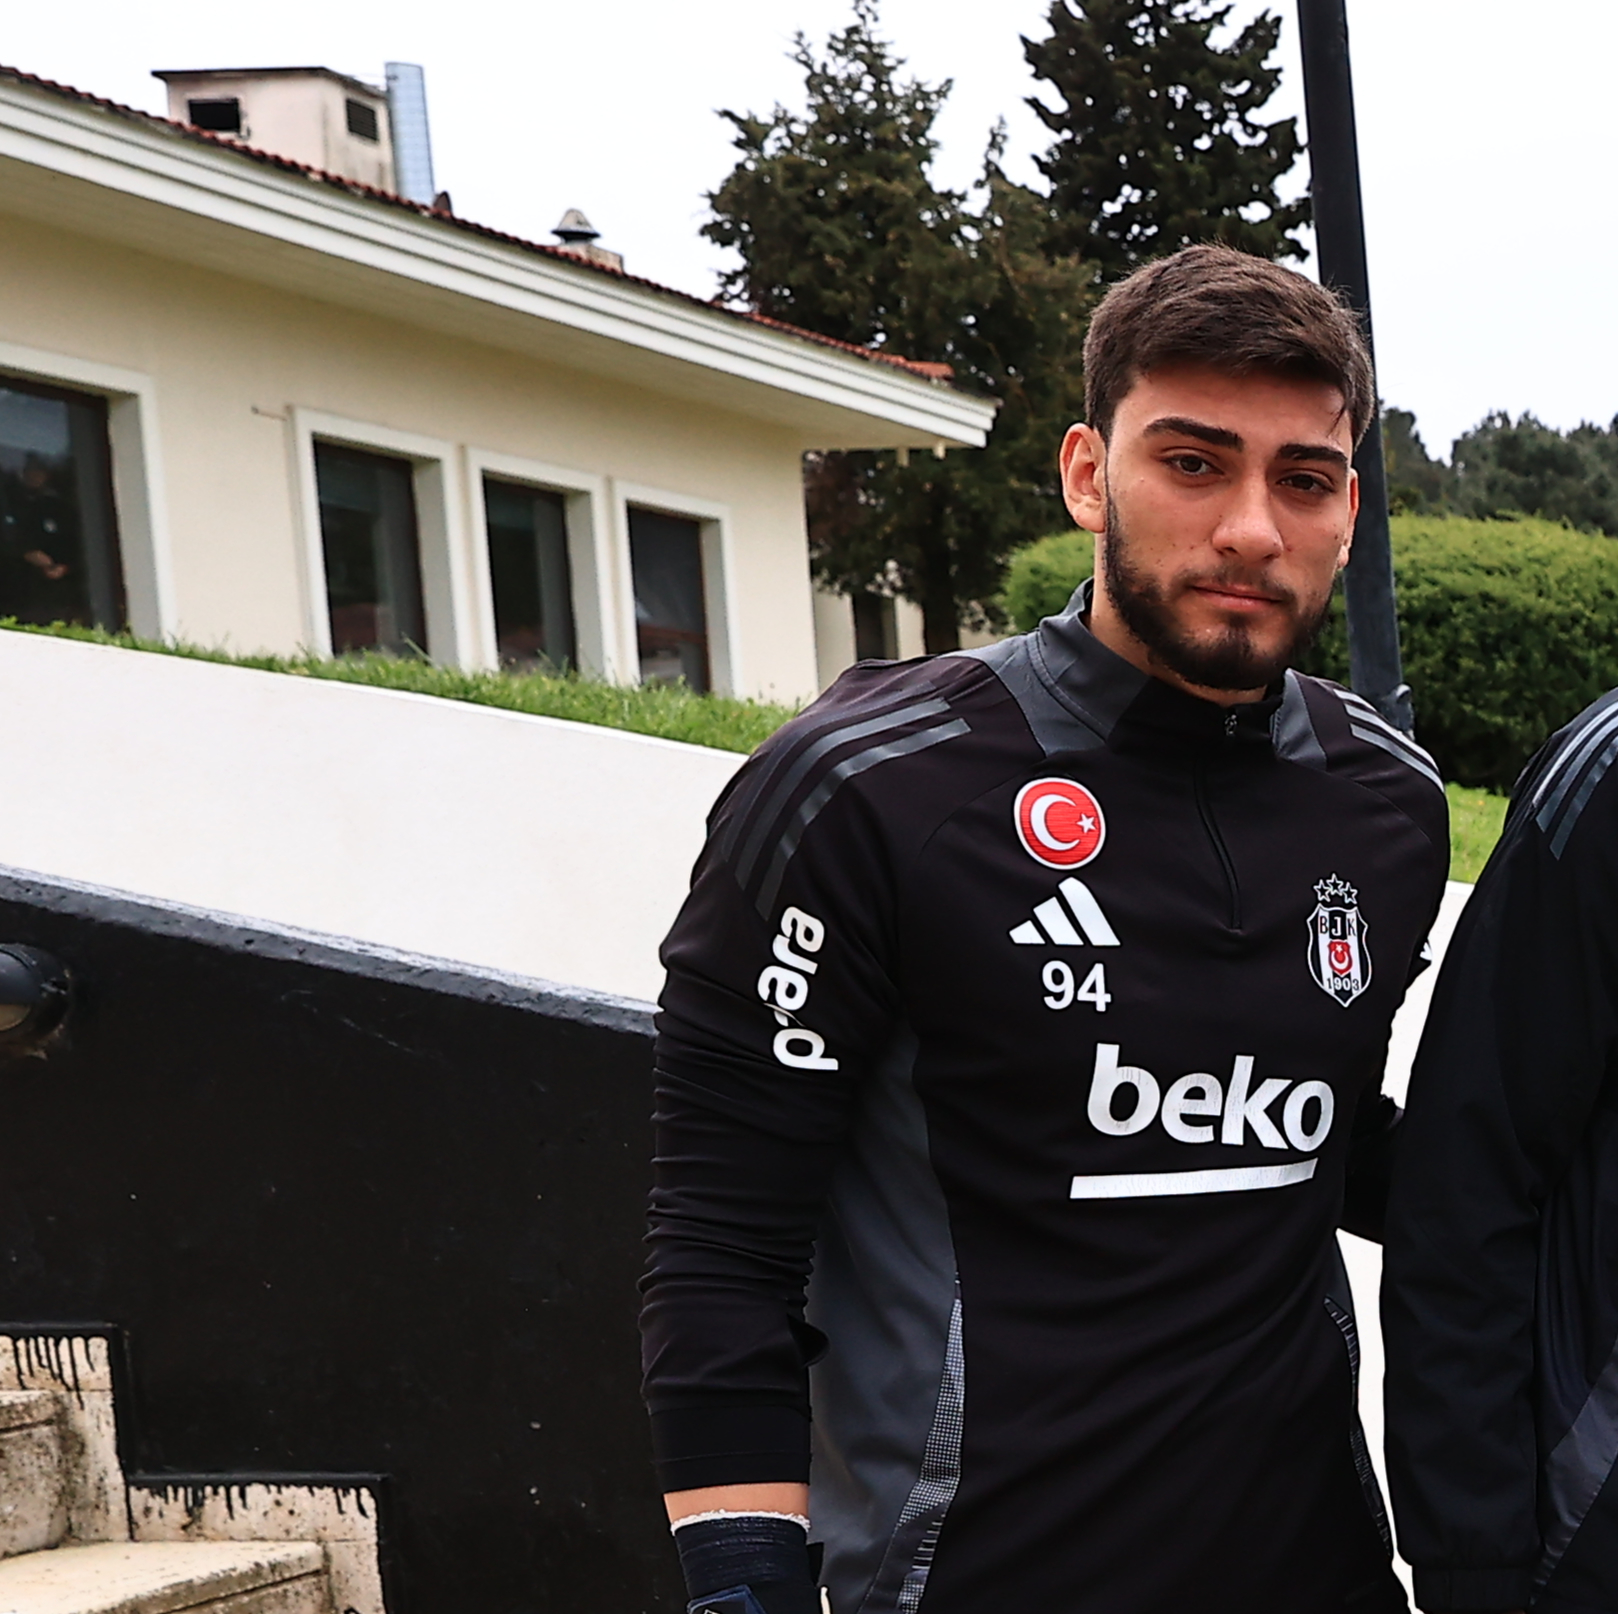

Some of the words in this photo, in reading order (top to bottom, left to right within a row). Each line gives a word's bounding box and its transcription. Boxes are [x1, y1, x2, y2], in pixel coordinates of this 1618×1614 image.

[1320, 915, 1356, 937] BJK
[1043, 961, 1111, 1011] 94
[1327, 977, 1360, 991] 1903
[1088, 1043, 1333, 1151] beko
